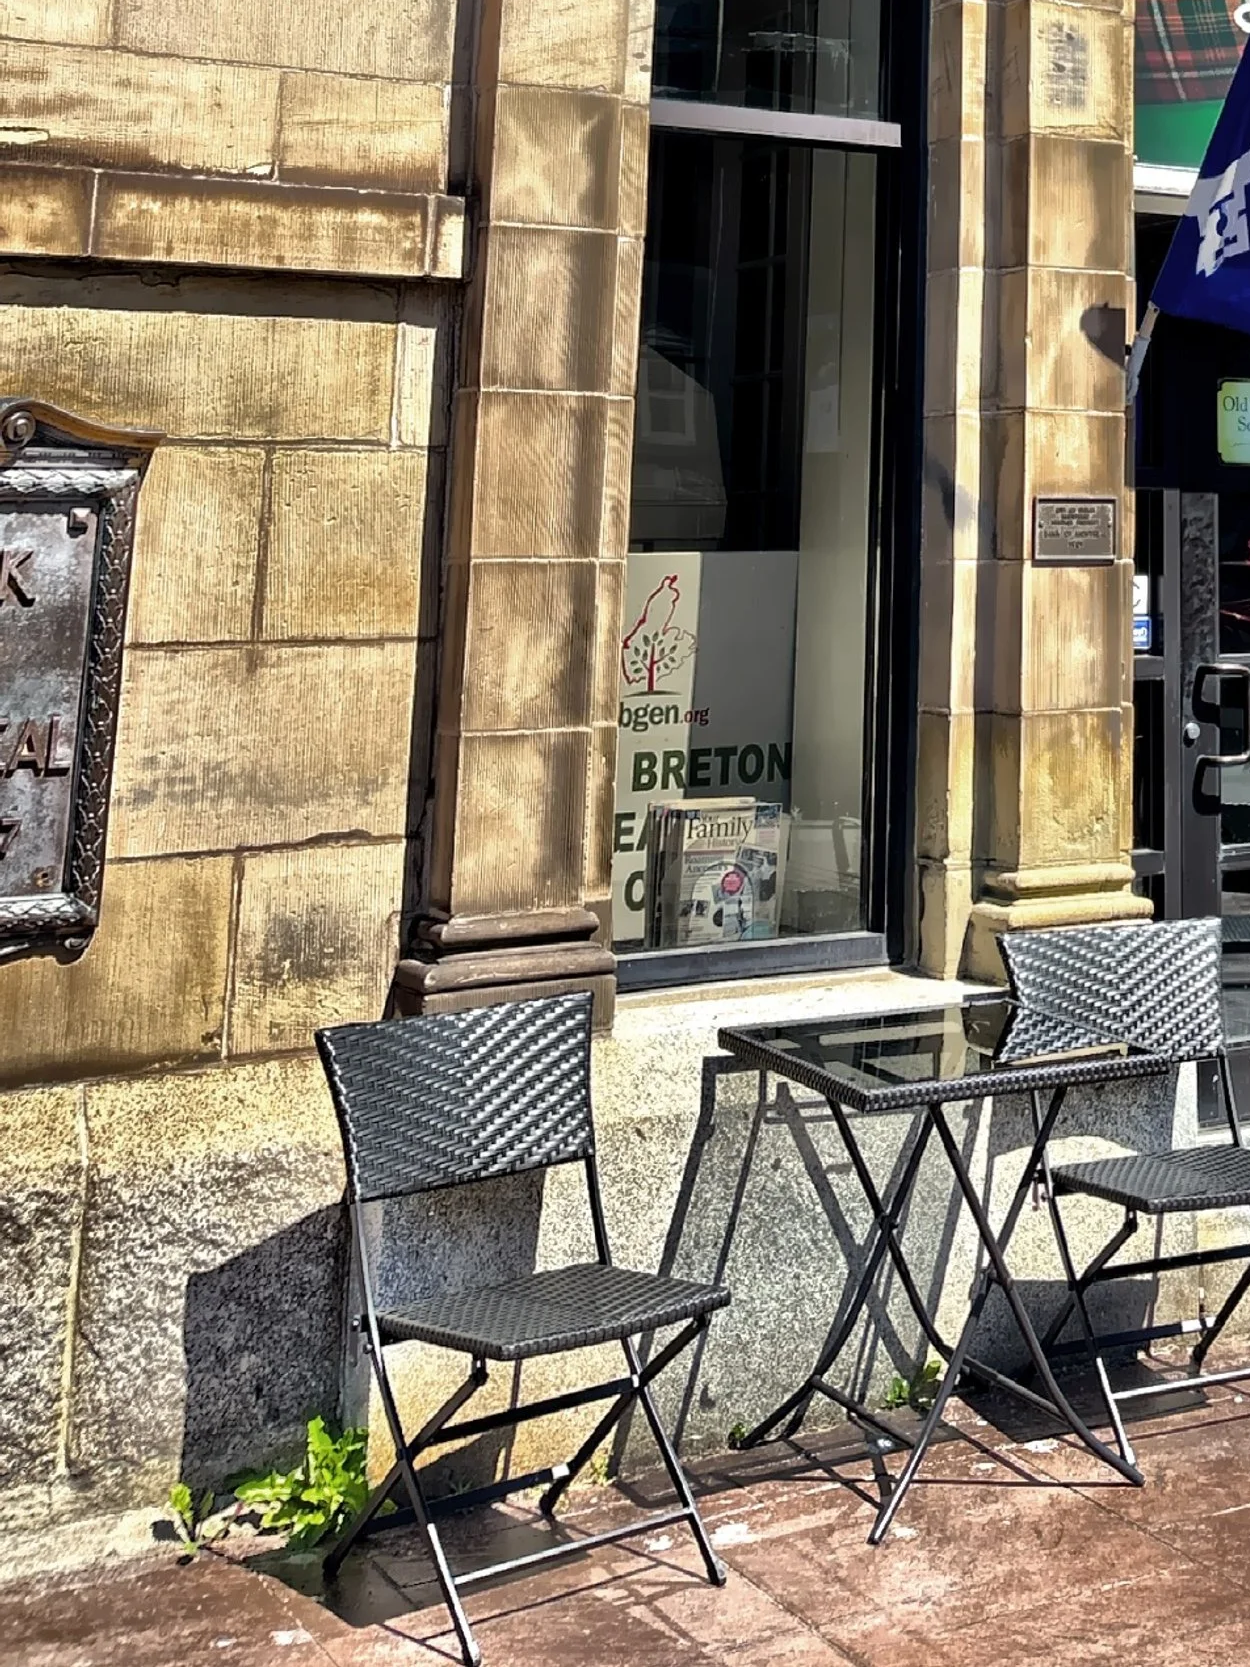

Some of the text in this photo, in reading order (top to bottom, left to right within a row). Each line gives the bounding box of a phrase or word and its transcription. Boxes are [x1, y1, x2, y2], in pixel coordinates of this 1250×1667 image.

[1223, 395, 1248, 412] Old
[618, 701, 710, 732] bgen.org
[632, 741, 792, 792] BRETON
[687, 816, 754, 843] Family
